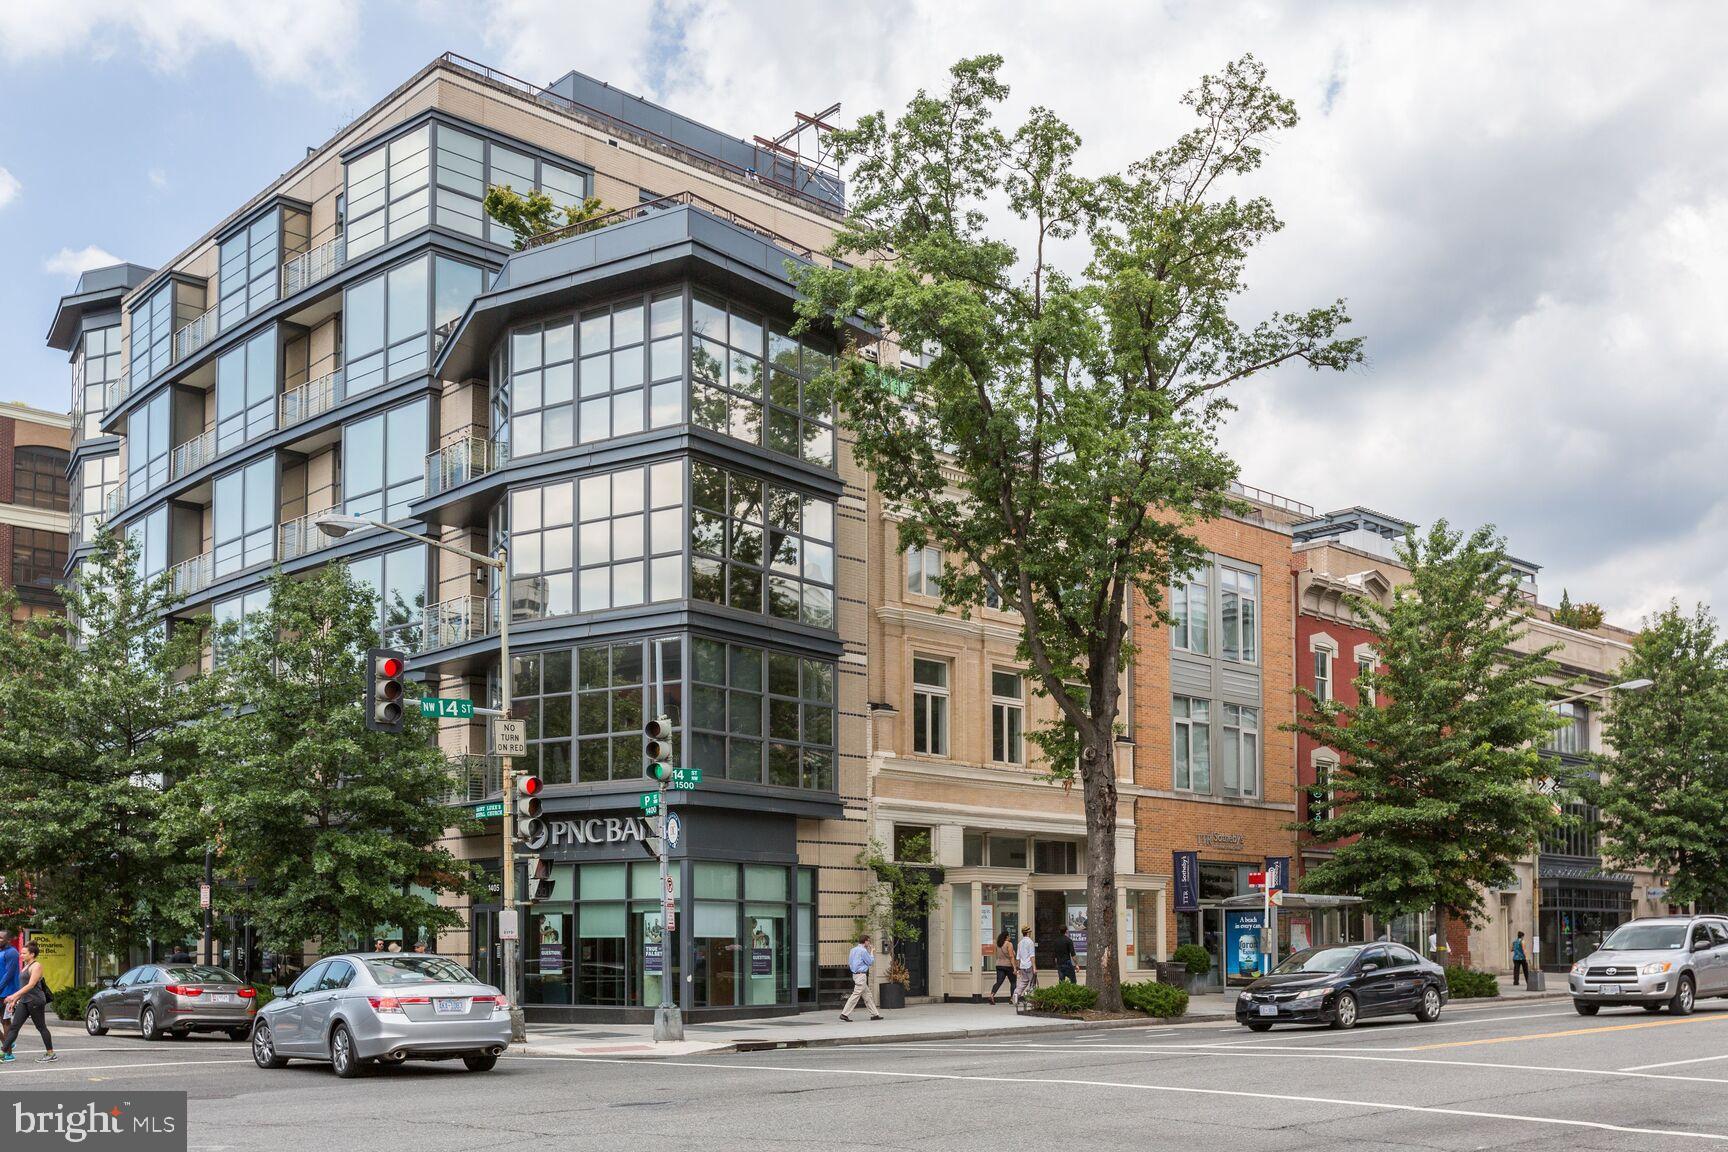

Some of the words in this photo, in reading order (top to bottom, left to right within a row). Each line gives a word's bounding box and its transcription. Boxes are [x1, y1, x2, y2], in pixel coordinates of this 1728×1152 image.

[422, 702, 435, 712] NW
[439, 700, 459, 716] 14
[461, 704, 472, 714] ST
[503, 724, 516, 732] NO
[501, 734, 520, 742] TURN
[497, 744, 508, 752] ON
[509, 744, 524, 752] RED
[673, 769, 685, 780] 14
[675, 781, 695, 790] 1500
[644, 795, 651, 806] P
[486, 809, 503, 817] CHURCH
[487, 884, 501, 892] 1405
